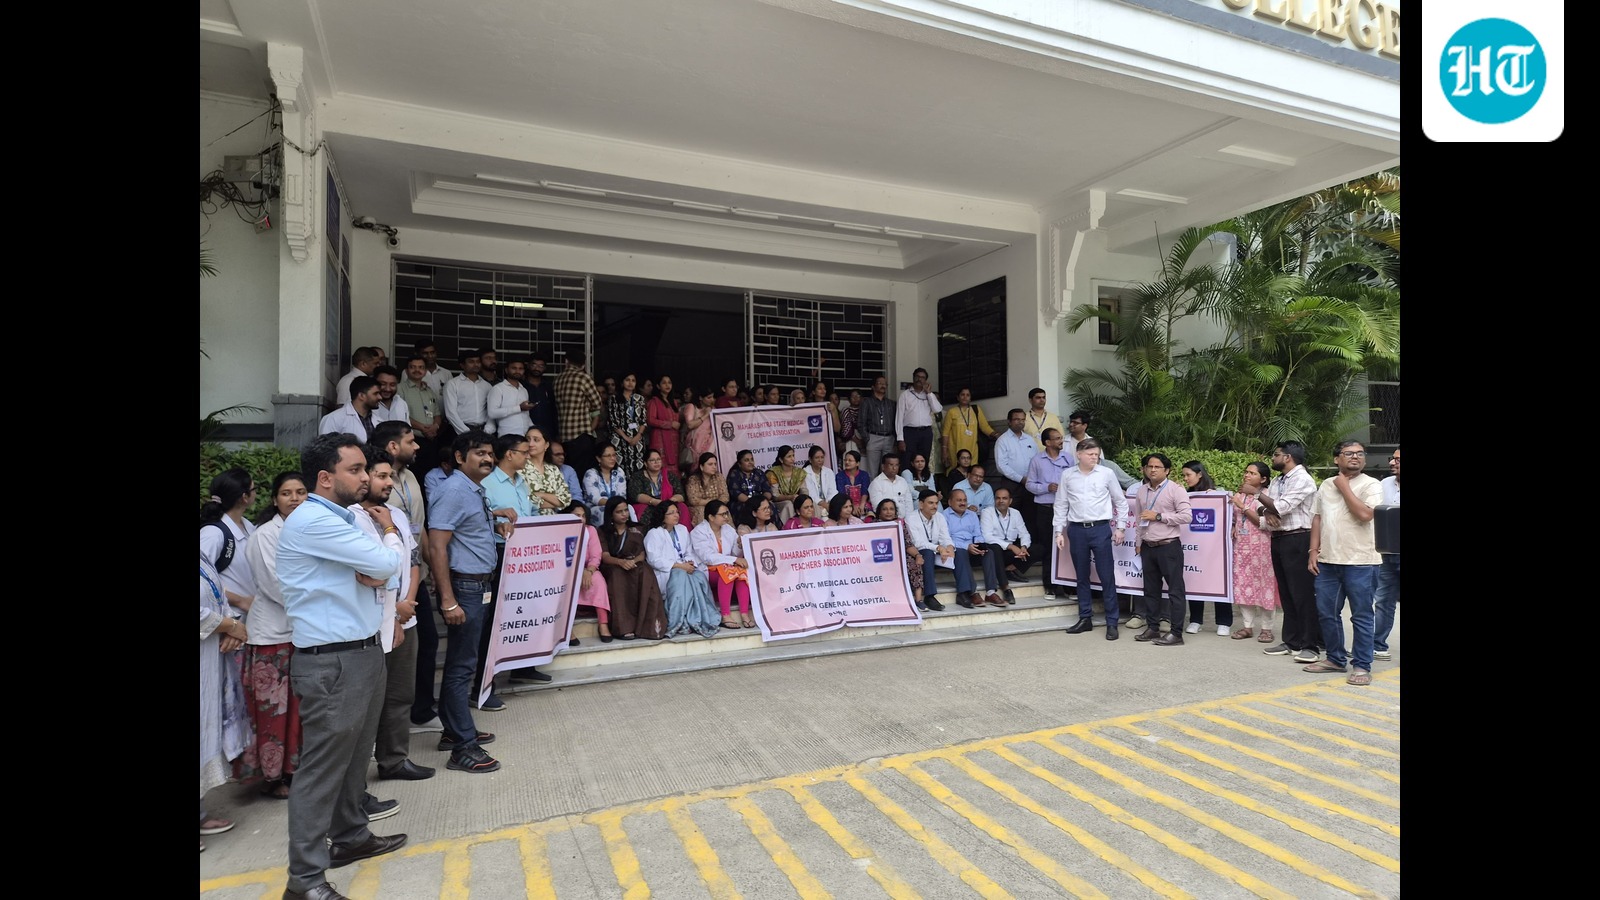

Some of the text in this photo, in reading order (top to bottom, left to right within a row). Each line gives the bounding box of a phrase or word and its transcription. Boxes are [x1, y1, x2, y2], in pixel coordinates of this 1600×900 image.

[737, 420, 772, 430] MAHARASHTRA
[786, 419, 804, 427] MEDICAL
[747, 430, 772, 439] TEACHERS
[773, 429, 800, 437] ASSOCIATION
[523, 545, 540, 557] STATE
[541, 543, 562, 555] MEDICAL
[779, 544, 867, 560] MAHARASHTRA STATE MEDICAL
[517, 560, 555, 574] ASSOCIATION
[790, 560, 822, 571] TEACHERS
[823, 556, 861, 567] ASSOCIATION
[779, 576, 883, 594] B.J. GOVT. MEDICAL COLLEGE
[504, 590, 542, 602] MEDICAL
[819, 601, 851, 609] GENERAL
[852, 596, 891, 606] HOSPITAL,
[516, 606, 523, 614] &
[502, 633, 529, 644] PUNE
